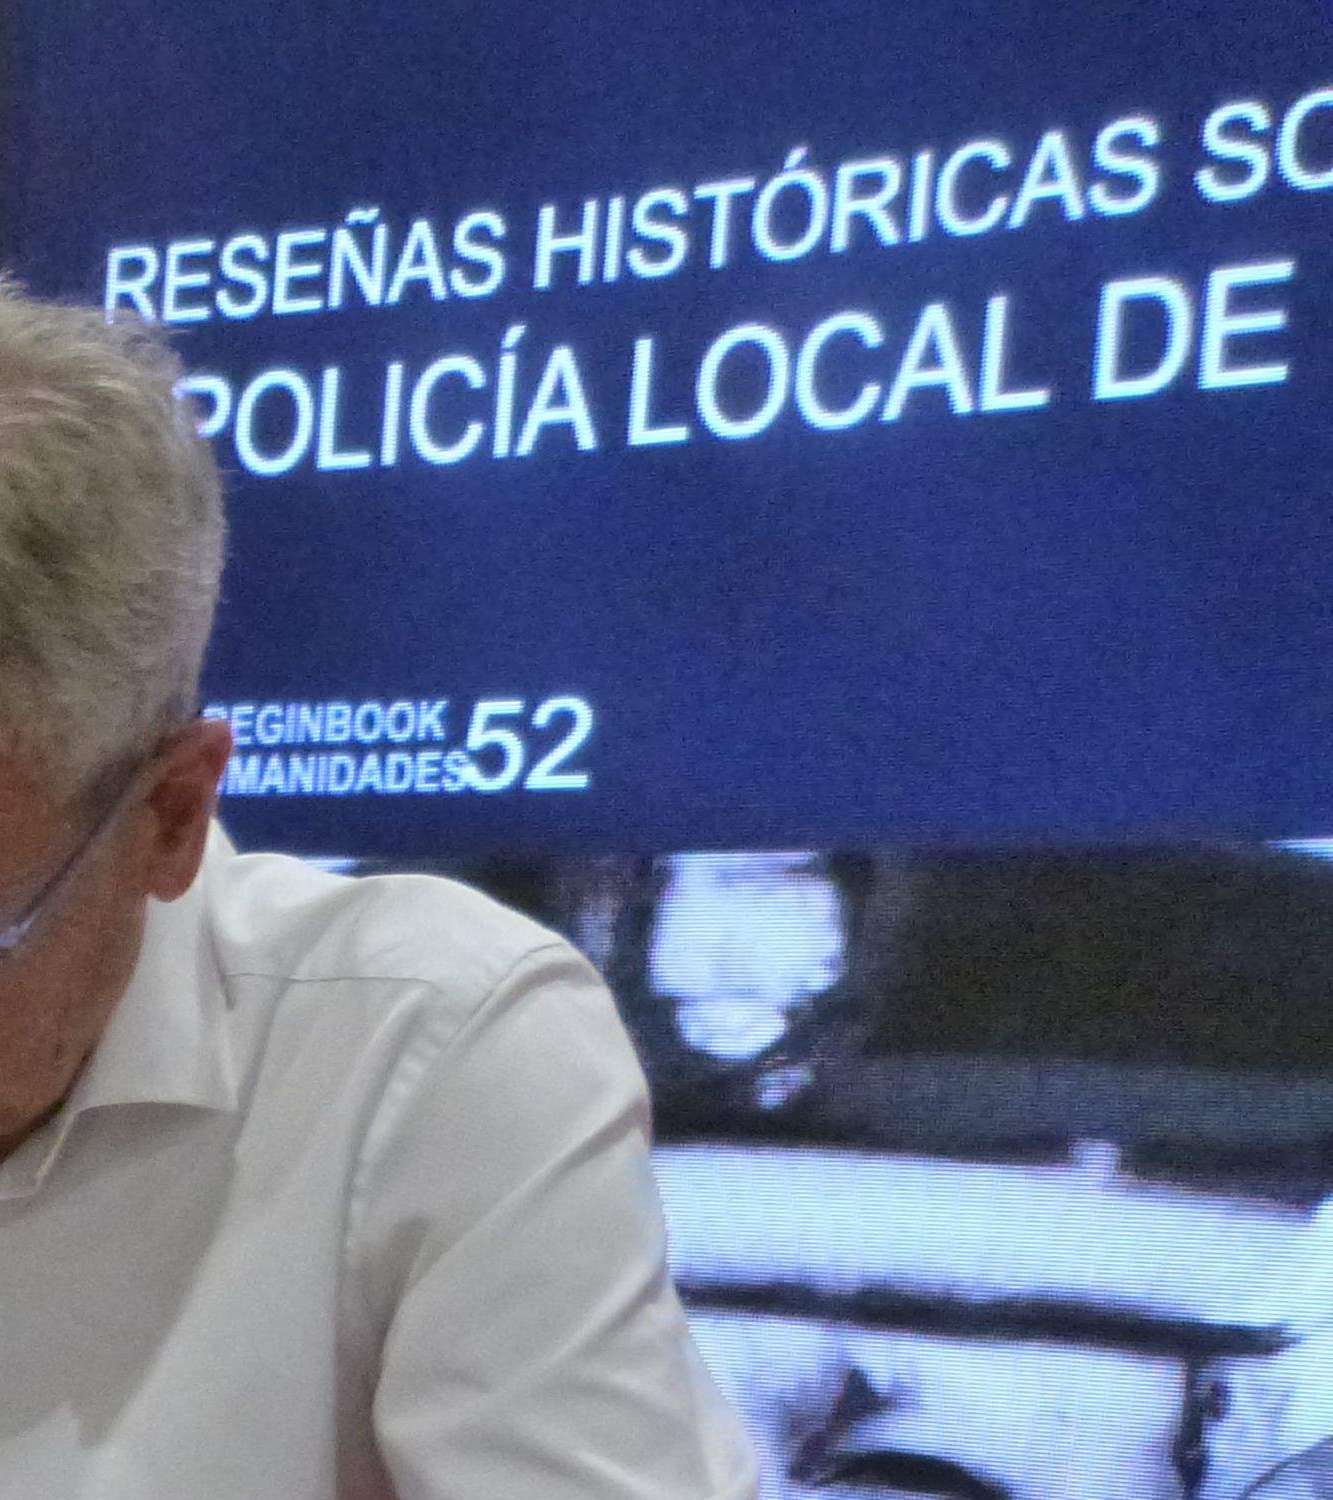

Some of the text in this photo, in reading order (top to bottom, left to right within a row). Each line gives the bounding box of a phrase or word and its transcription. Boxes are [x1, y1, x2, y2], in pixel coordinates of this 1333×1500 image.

[106, 206, 507, 325] RESEÑAS
[533, 114, 1159, 290] HISTÓRICAS
[627, 296, 1051, 446] LOCAL
[1093, 260, 1296, 400] DE
[202, 697, 593, 792] EGINBOOK 52
[217, 752, 471, 796] MANIDADES
